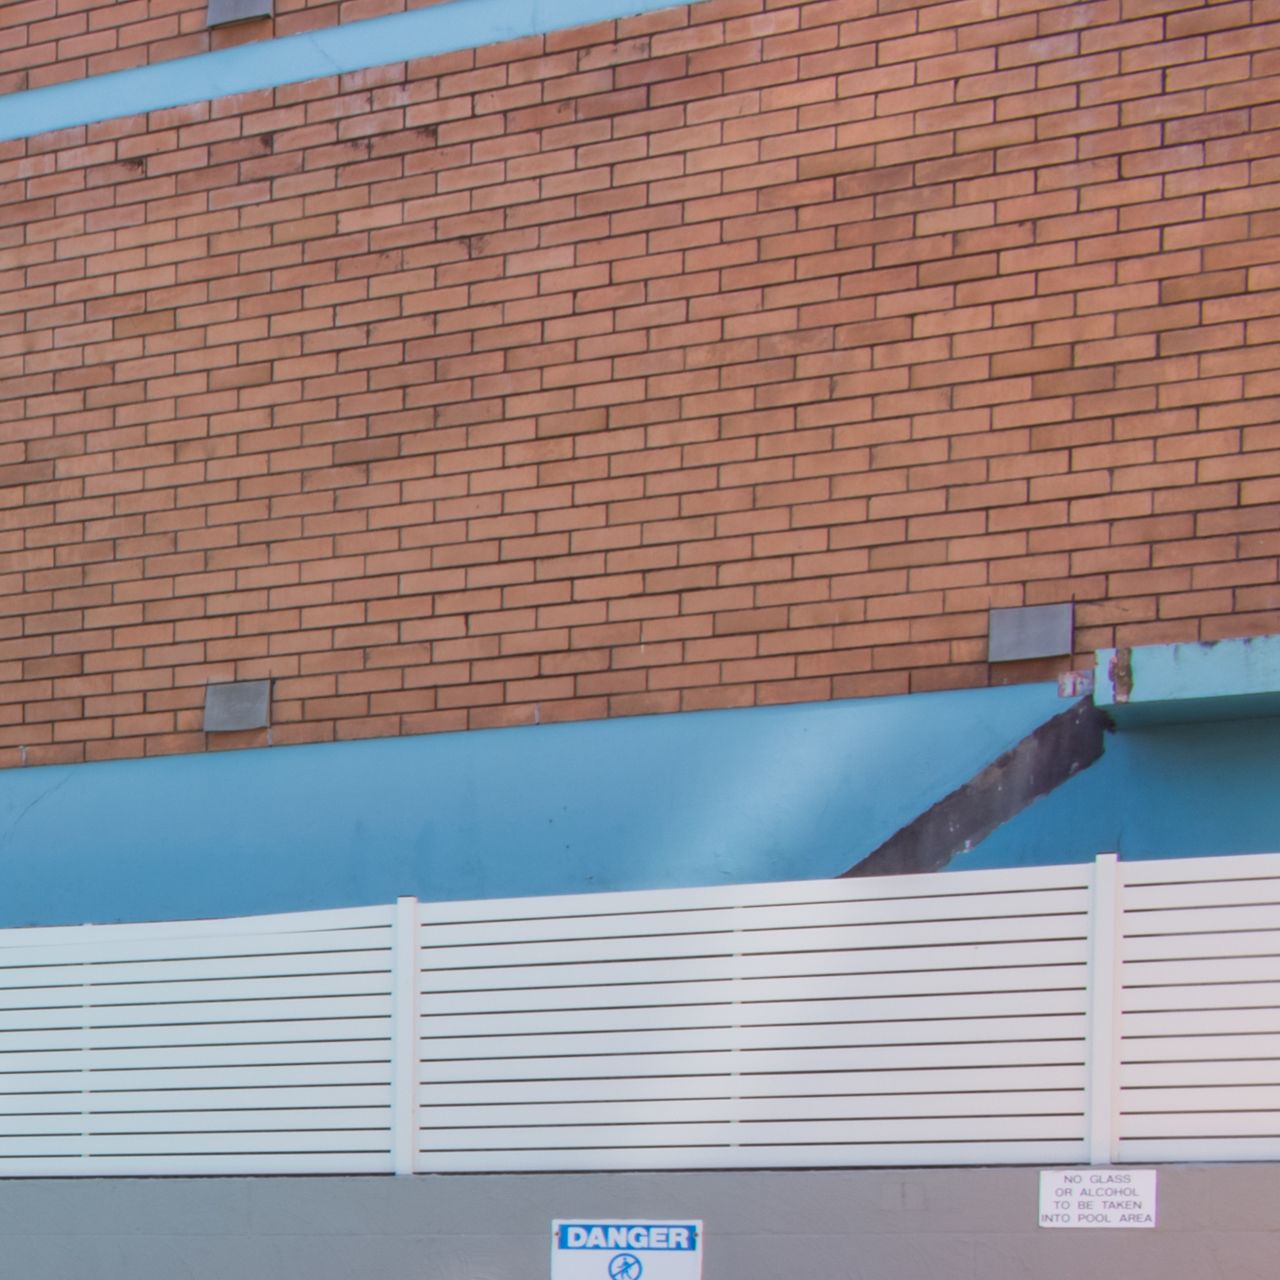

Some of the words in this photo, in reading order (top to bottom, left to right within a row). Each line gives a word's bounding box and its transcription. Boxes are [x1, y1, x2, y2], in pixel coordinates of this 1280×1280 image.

[1064, 1175, 1082, 1184] NO
[1090, 1175, 1131, 1184] GLASS
[1055, 1188, 1072, 1197] OR
[1080, 1187, 1139, 1197] ALCOHOL
[1054, 1201, 1070, 1210] TO
[1078, 1201, 1093, 1210] BE
[1103, 1200, 1142, 1210] TAKEN
[1041, 1213, 1071, 1223] INTO
[1078, 1213, 1111, 1223] POOL
[1120, 1213, 1153, 1223] AREA
[566, 1226, 689, 1249] DANGER
